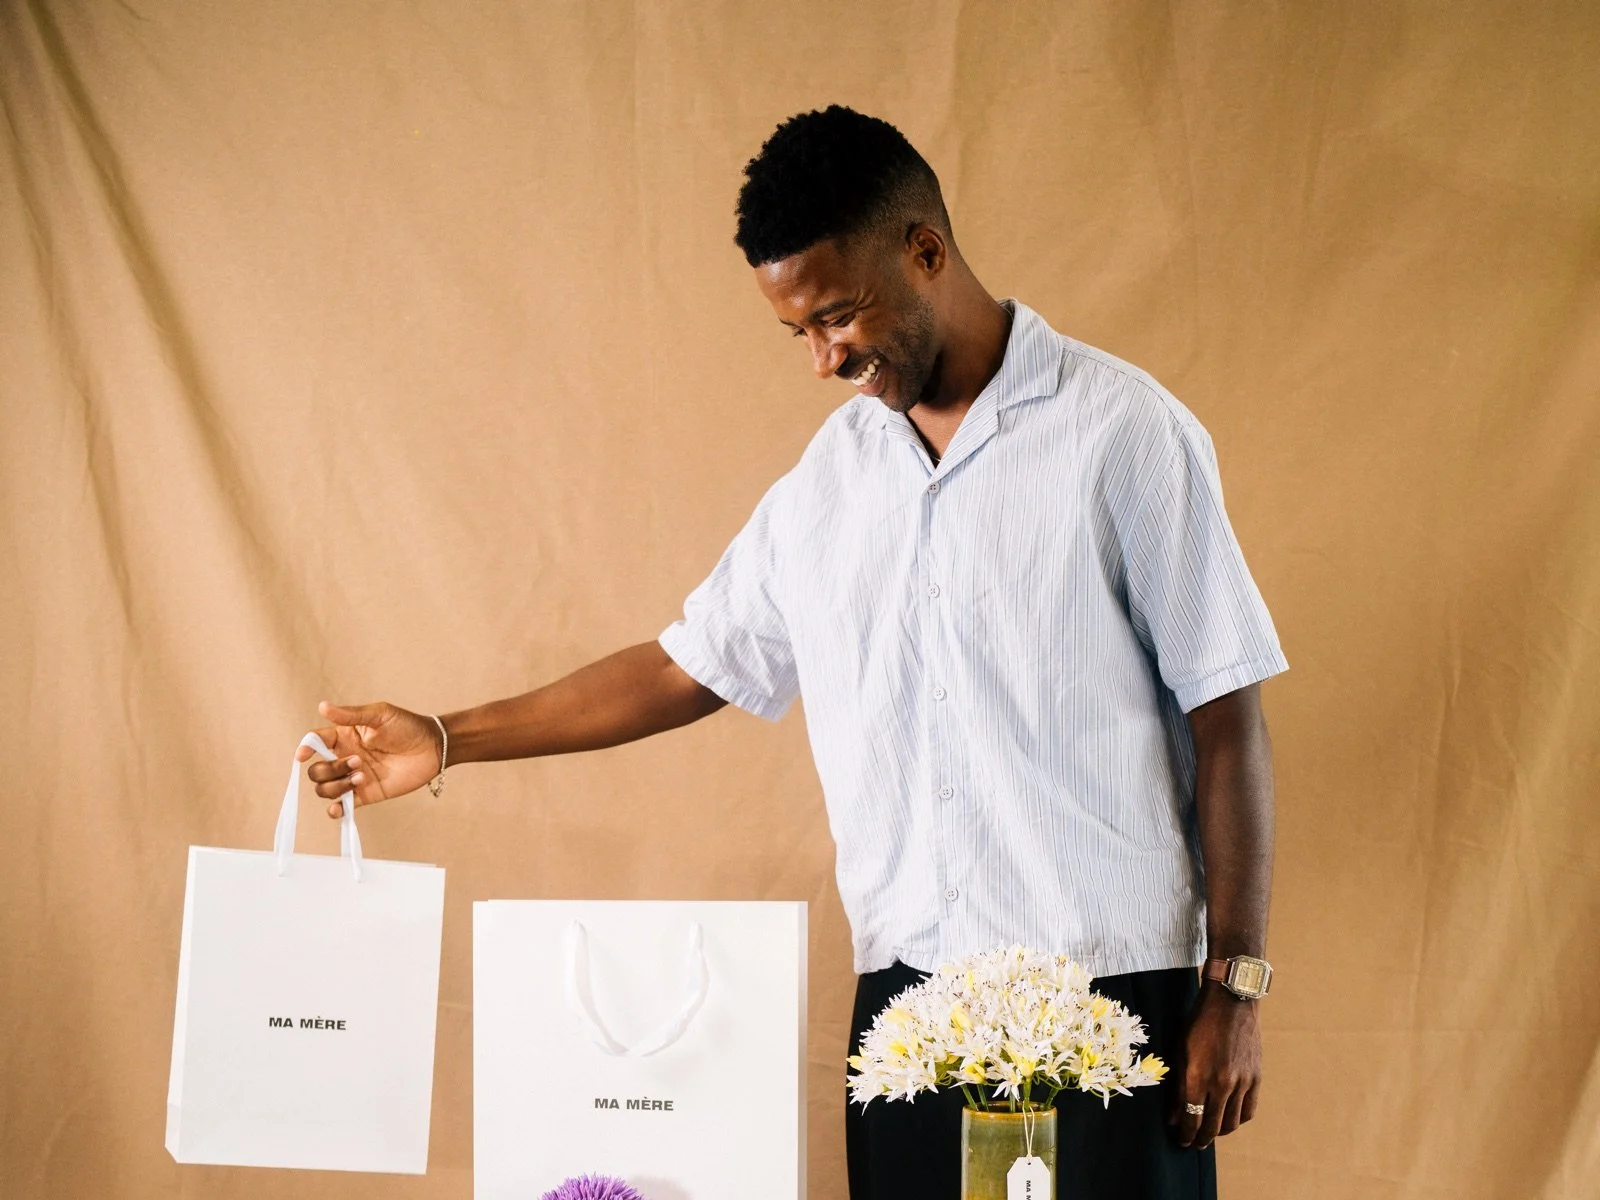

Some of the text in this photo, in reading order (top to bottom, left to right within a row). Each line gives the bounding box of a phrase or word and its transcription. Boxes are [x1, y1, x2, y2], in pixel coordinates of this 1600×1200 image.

[269, 1015, 347, 1031] MA MÈRE
[595, 1096, 674, 1111] MA MÈRE
[1025, 1180, 1031, 1193] MA
